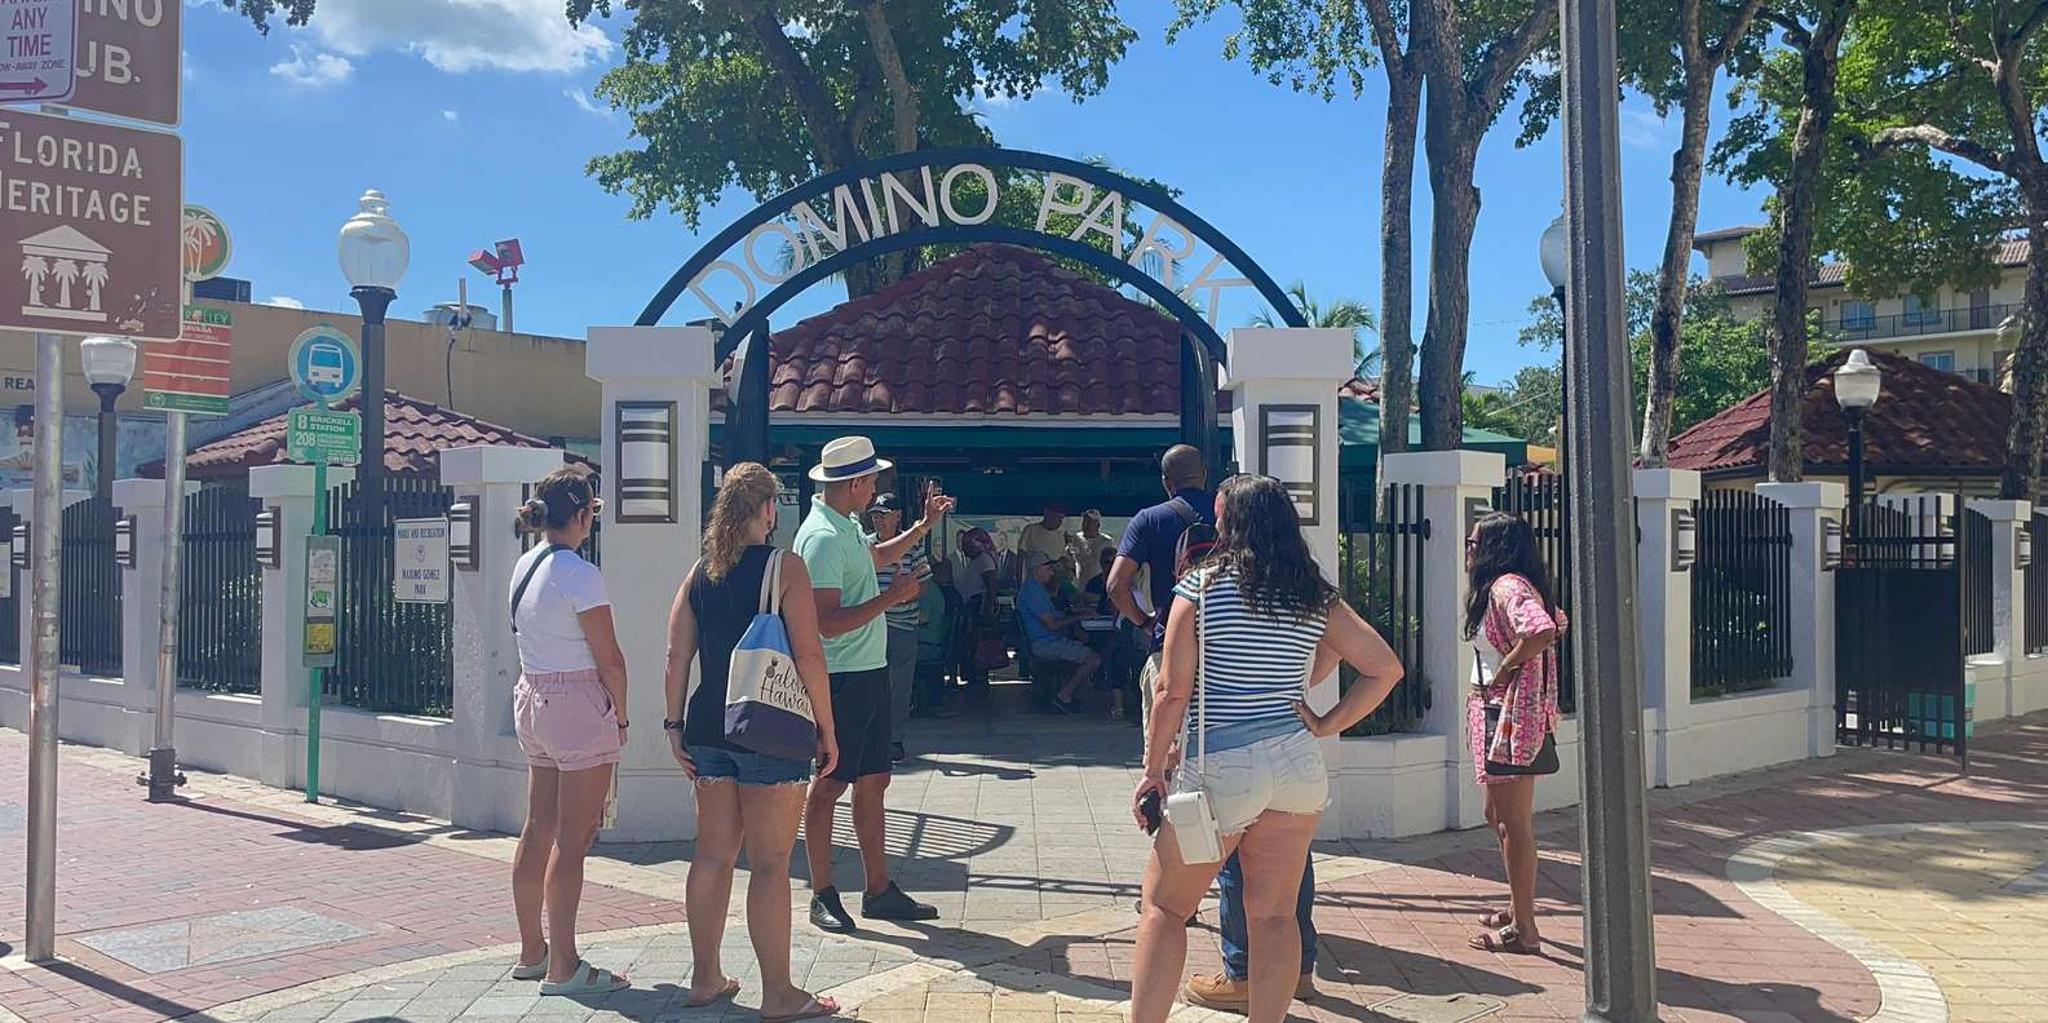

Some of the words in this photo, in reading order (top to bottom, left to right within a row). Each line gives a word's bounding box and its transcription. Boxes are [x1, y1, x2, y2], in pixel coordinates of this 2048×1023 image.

[11, 7, 48, 30] ANY
[6, 33, 52, 57] TIME
[40, 59, 65, 70] ZONE
[0, 169, 151, 226] ERITAGE
[686, 163, 998, 325] DOMINO
[1035, 171, 1253, 328] PARK
[297, 414, 308, 430] 8
[309, 423, 346, 433] STATION
[295, 431, 316, 447] 208
